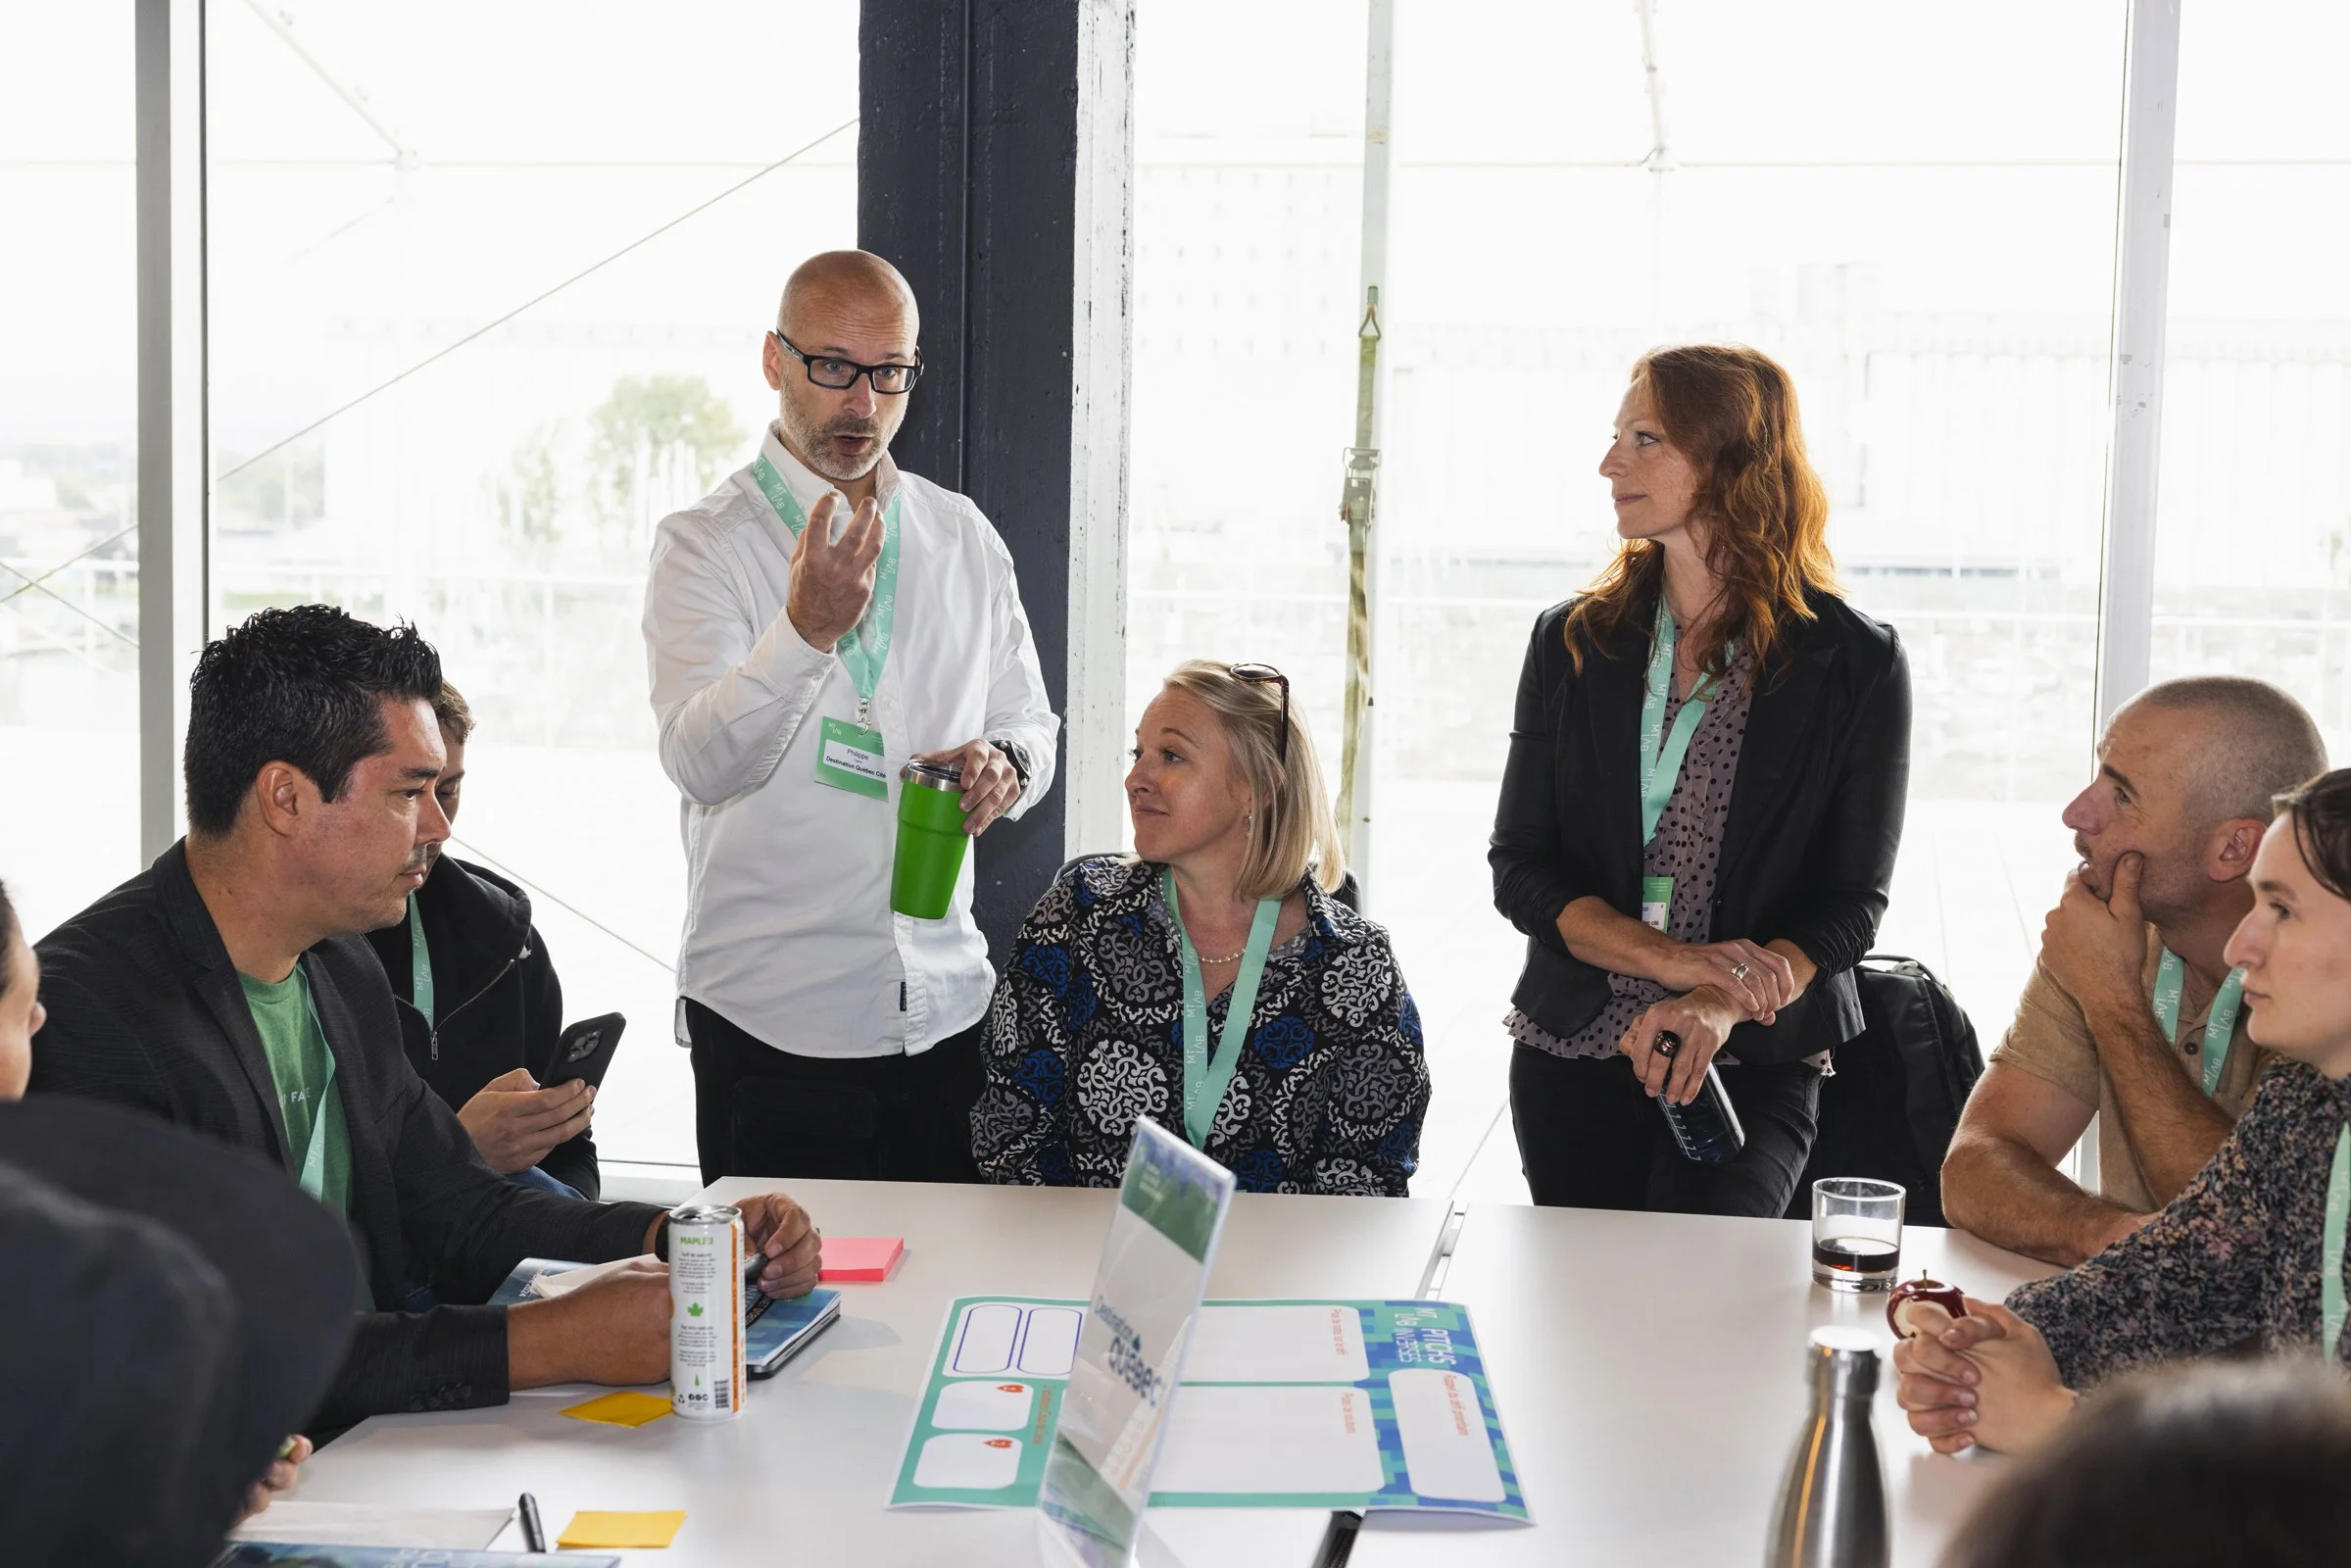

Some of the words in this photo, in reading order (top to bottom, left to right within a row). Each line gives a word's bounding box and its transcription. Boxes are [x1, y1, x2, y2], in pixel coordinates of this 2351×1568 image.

[773, 482, 787, 497] MT
[770, 494, 785, 510] LAB
[886, 557, 897, 574] LAB
[884, 594, 894, 612] LAB
[1661, 643, 1672, 658] MT
[1657, 683, 1668, 697] MT
[1651, 724, 1660, 738] MT
[1641, 734, 1652, 752] LAB
[826, 756, 855, 768] Destination
[847, 749, 868, 760] Philippe
[1189, 948, 1199, 966] LAB
[420, 963, 430, 982] LAB
[416, 976, 423, 991] MT
[1192, 990, 1204, 1007] LAB
[2168, 989, 2179, 1005] MT
[1187, 1003, 1196, 1018] MT
[2219, 1009, 2234, 1031] LAB
[2208, 1021, 2219, 1039] MT
[1194, 1034, 1205, 1054] LAB
[1187, 1049, 1196, 1064] MT
[2203, 1066, 2213, 1085] MT
[2210, 1057, 2222, 1079] LAB
[1187, 1096, 1196, 1110] MT
[1420, 1328, 1457, 1365] PITCHS
